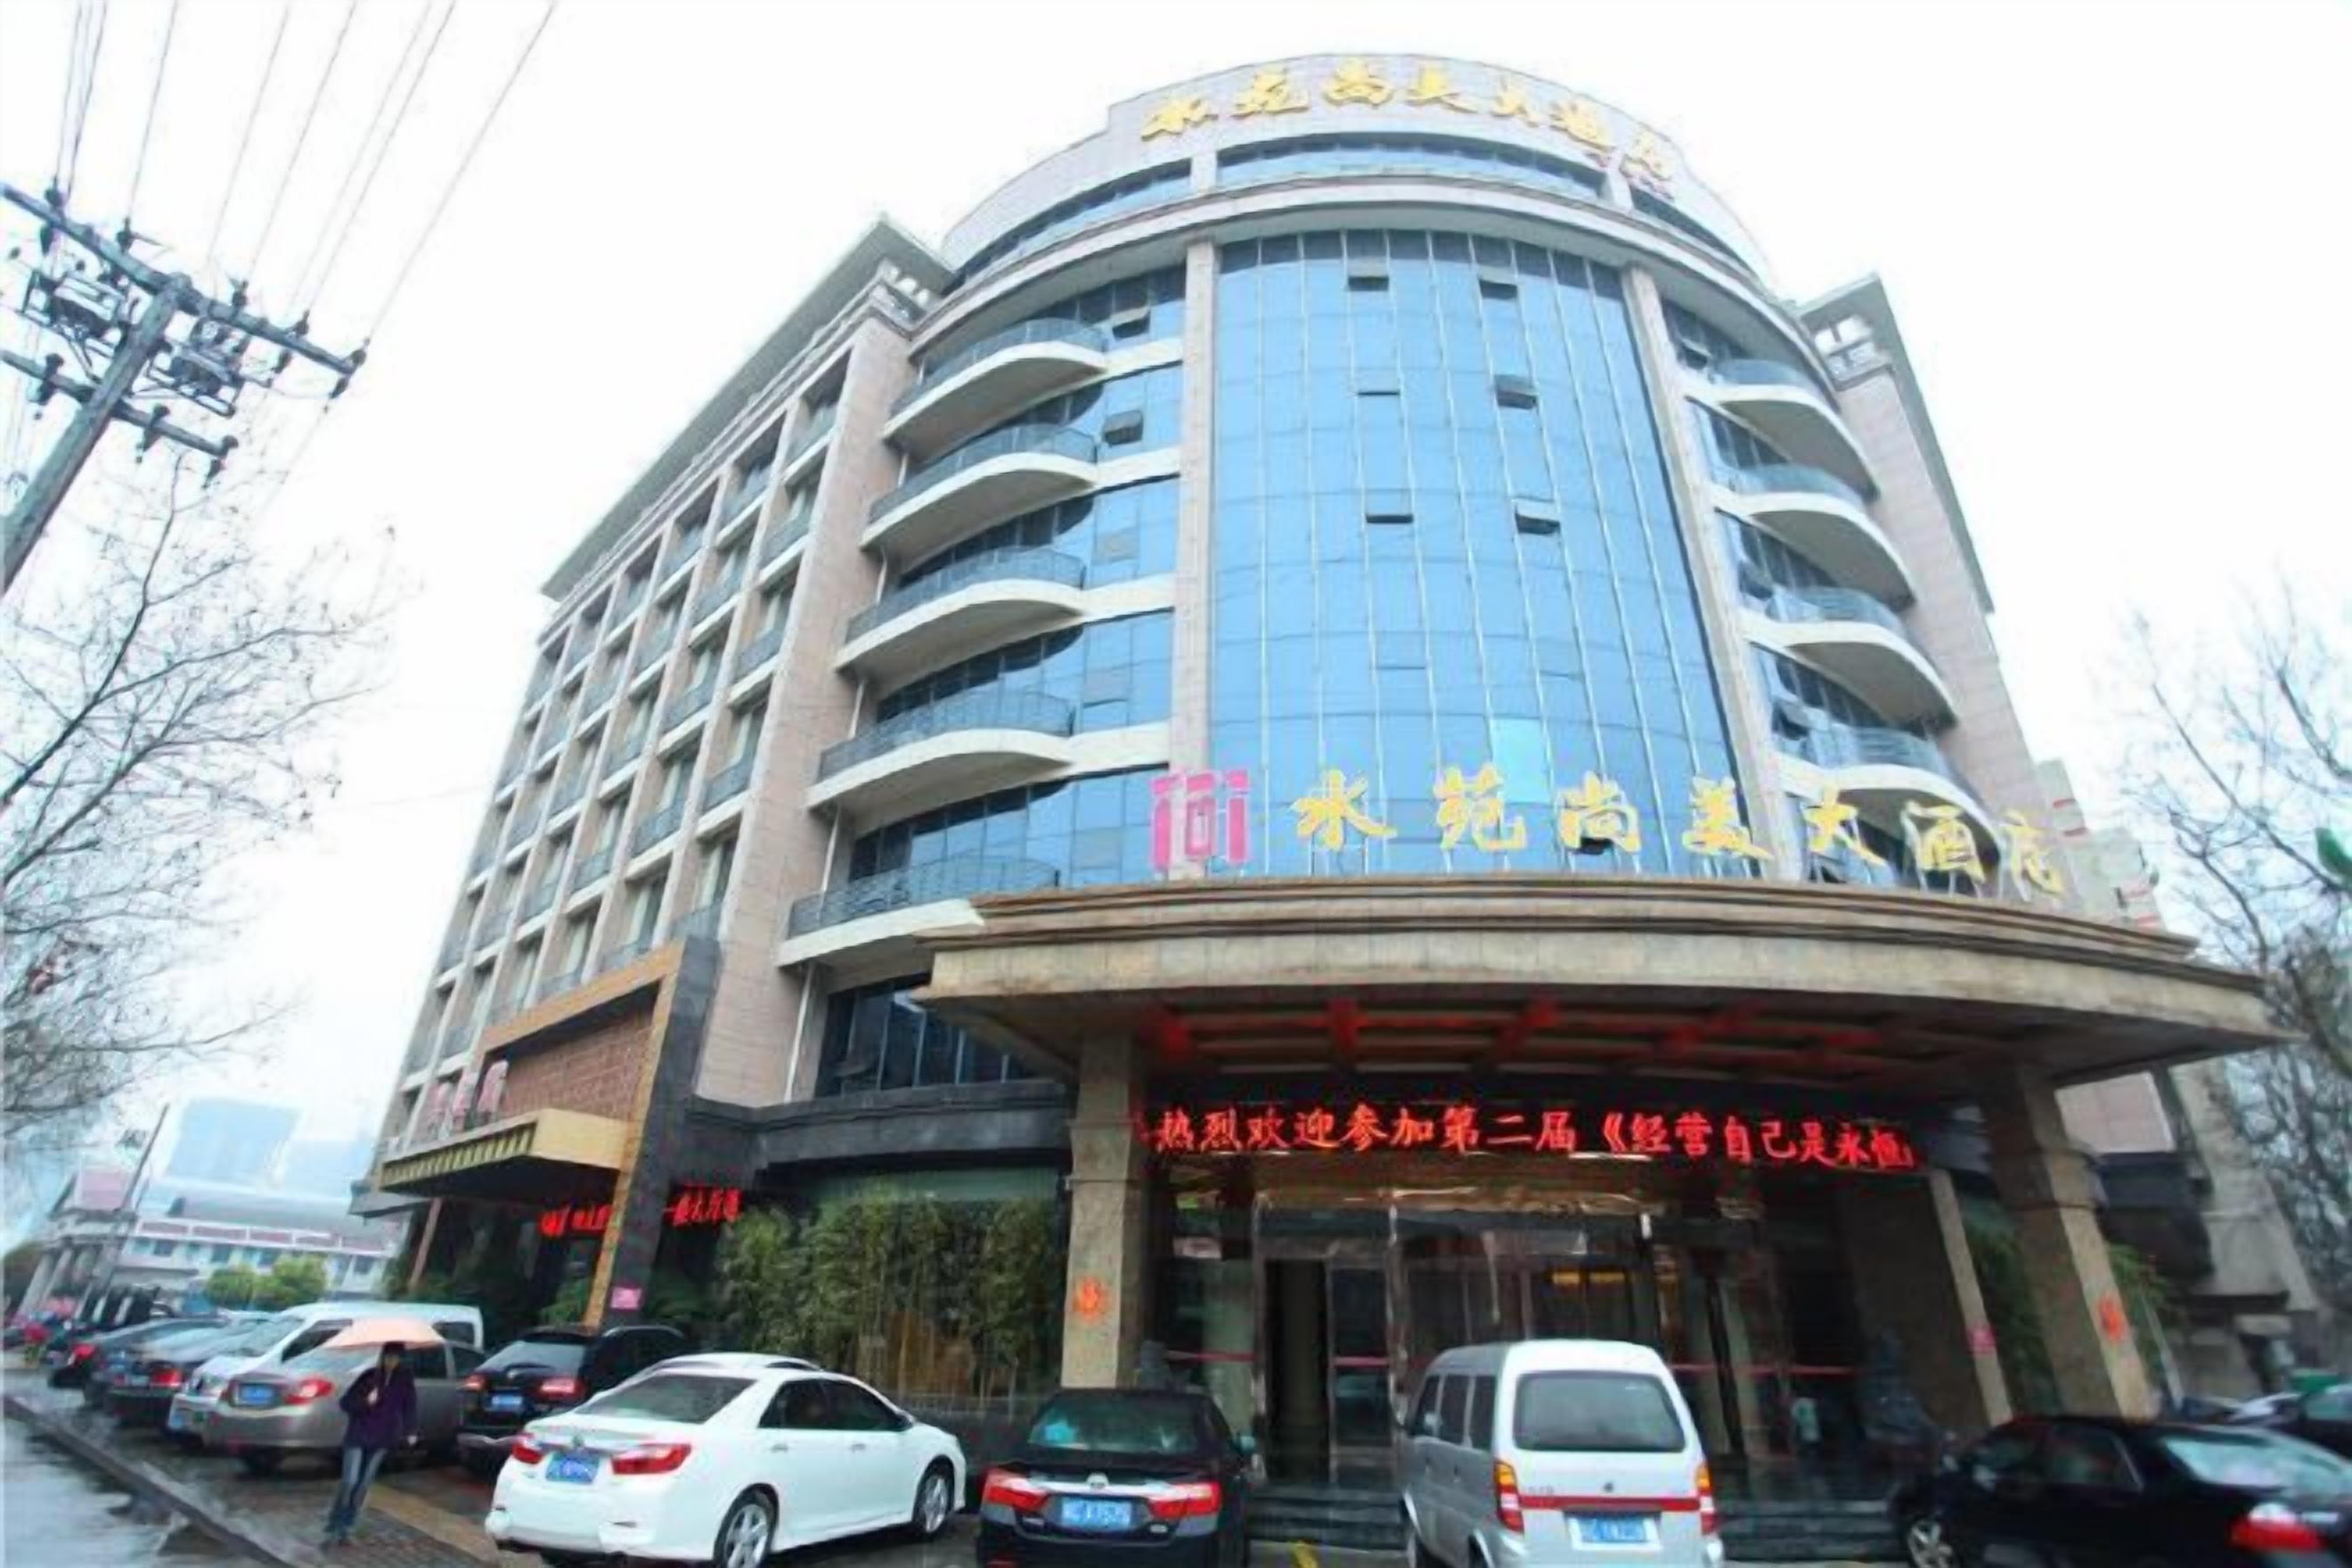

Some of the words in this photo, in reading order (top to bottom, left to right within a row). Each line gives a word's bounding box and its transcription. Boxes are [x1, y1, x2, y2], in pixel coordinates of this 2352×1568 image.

[1290, 764, 2066, 895] 水苑尚美大酒店
